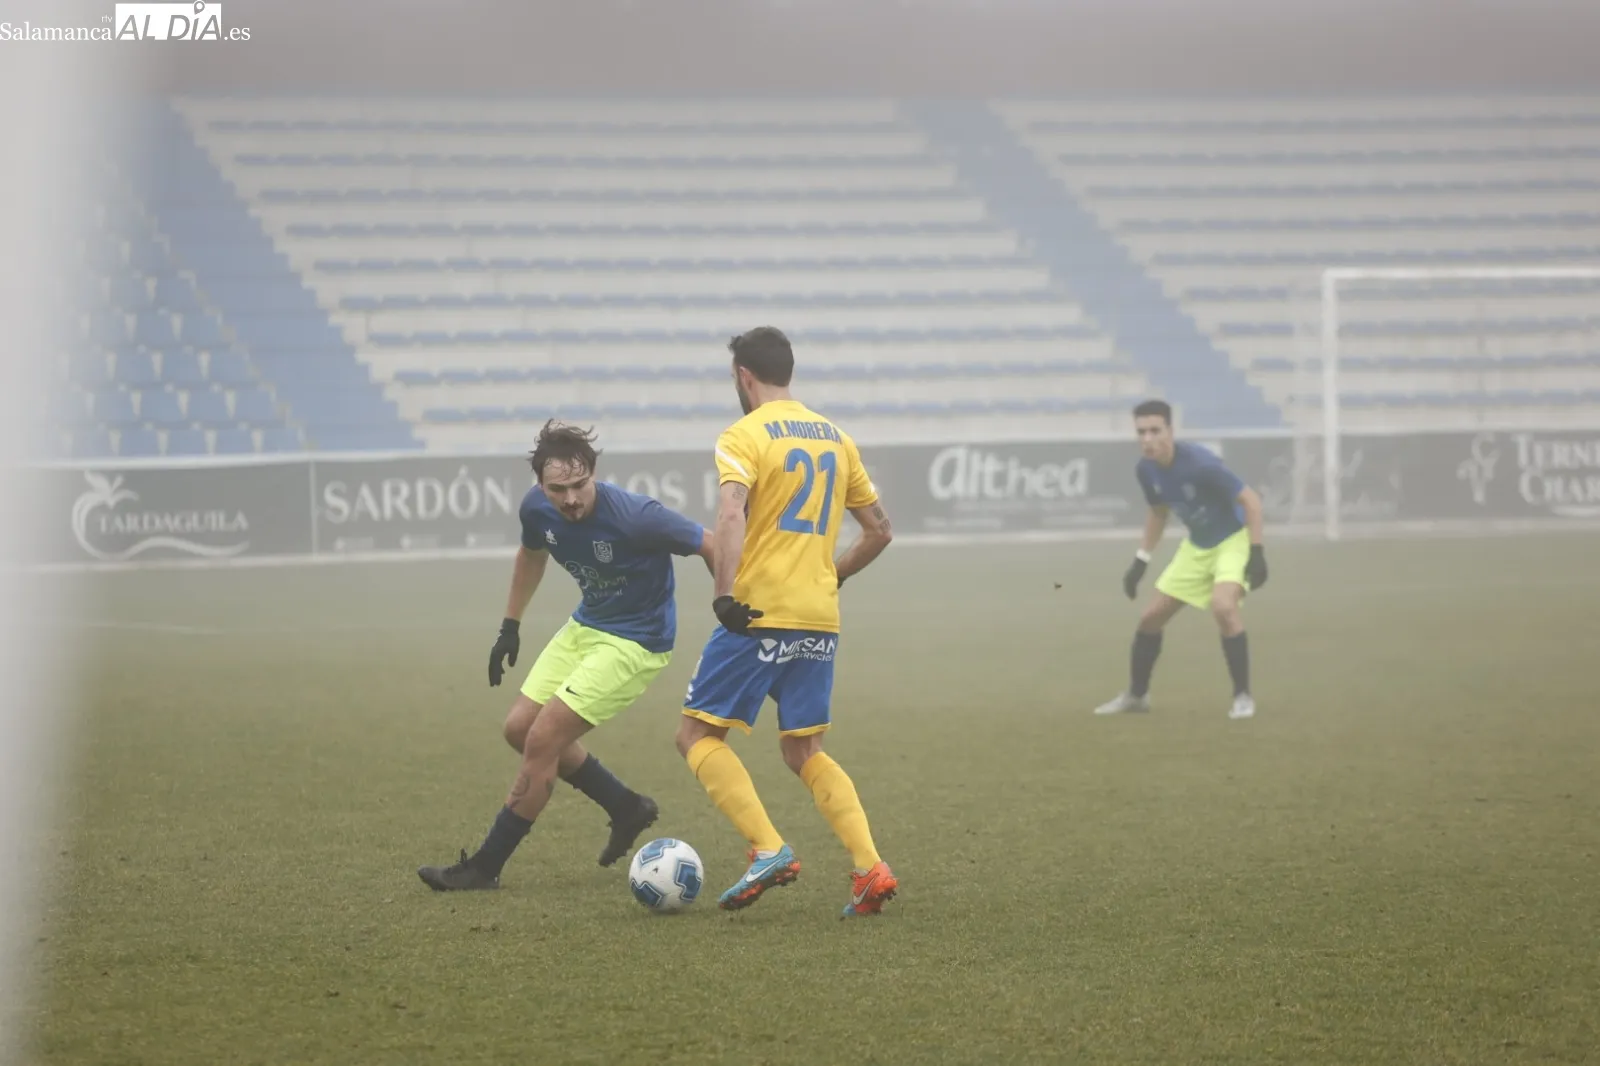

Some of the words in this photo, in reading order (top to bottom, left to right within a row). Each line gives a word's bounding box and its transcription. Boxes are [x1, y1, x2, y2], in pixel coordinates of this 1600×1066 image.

[764, 419, 843, 445] M.MOREIRA
[1510, 433, 1600, 468] TERN
[322, 465, 512, 524] SARDÓN
[604, 469, 688, 511] OS
[777, 447, 836, 536] 21
